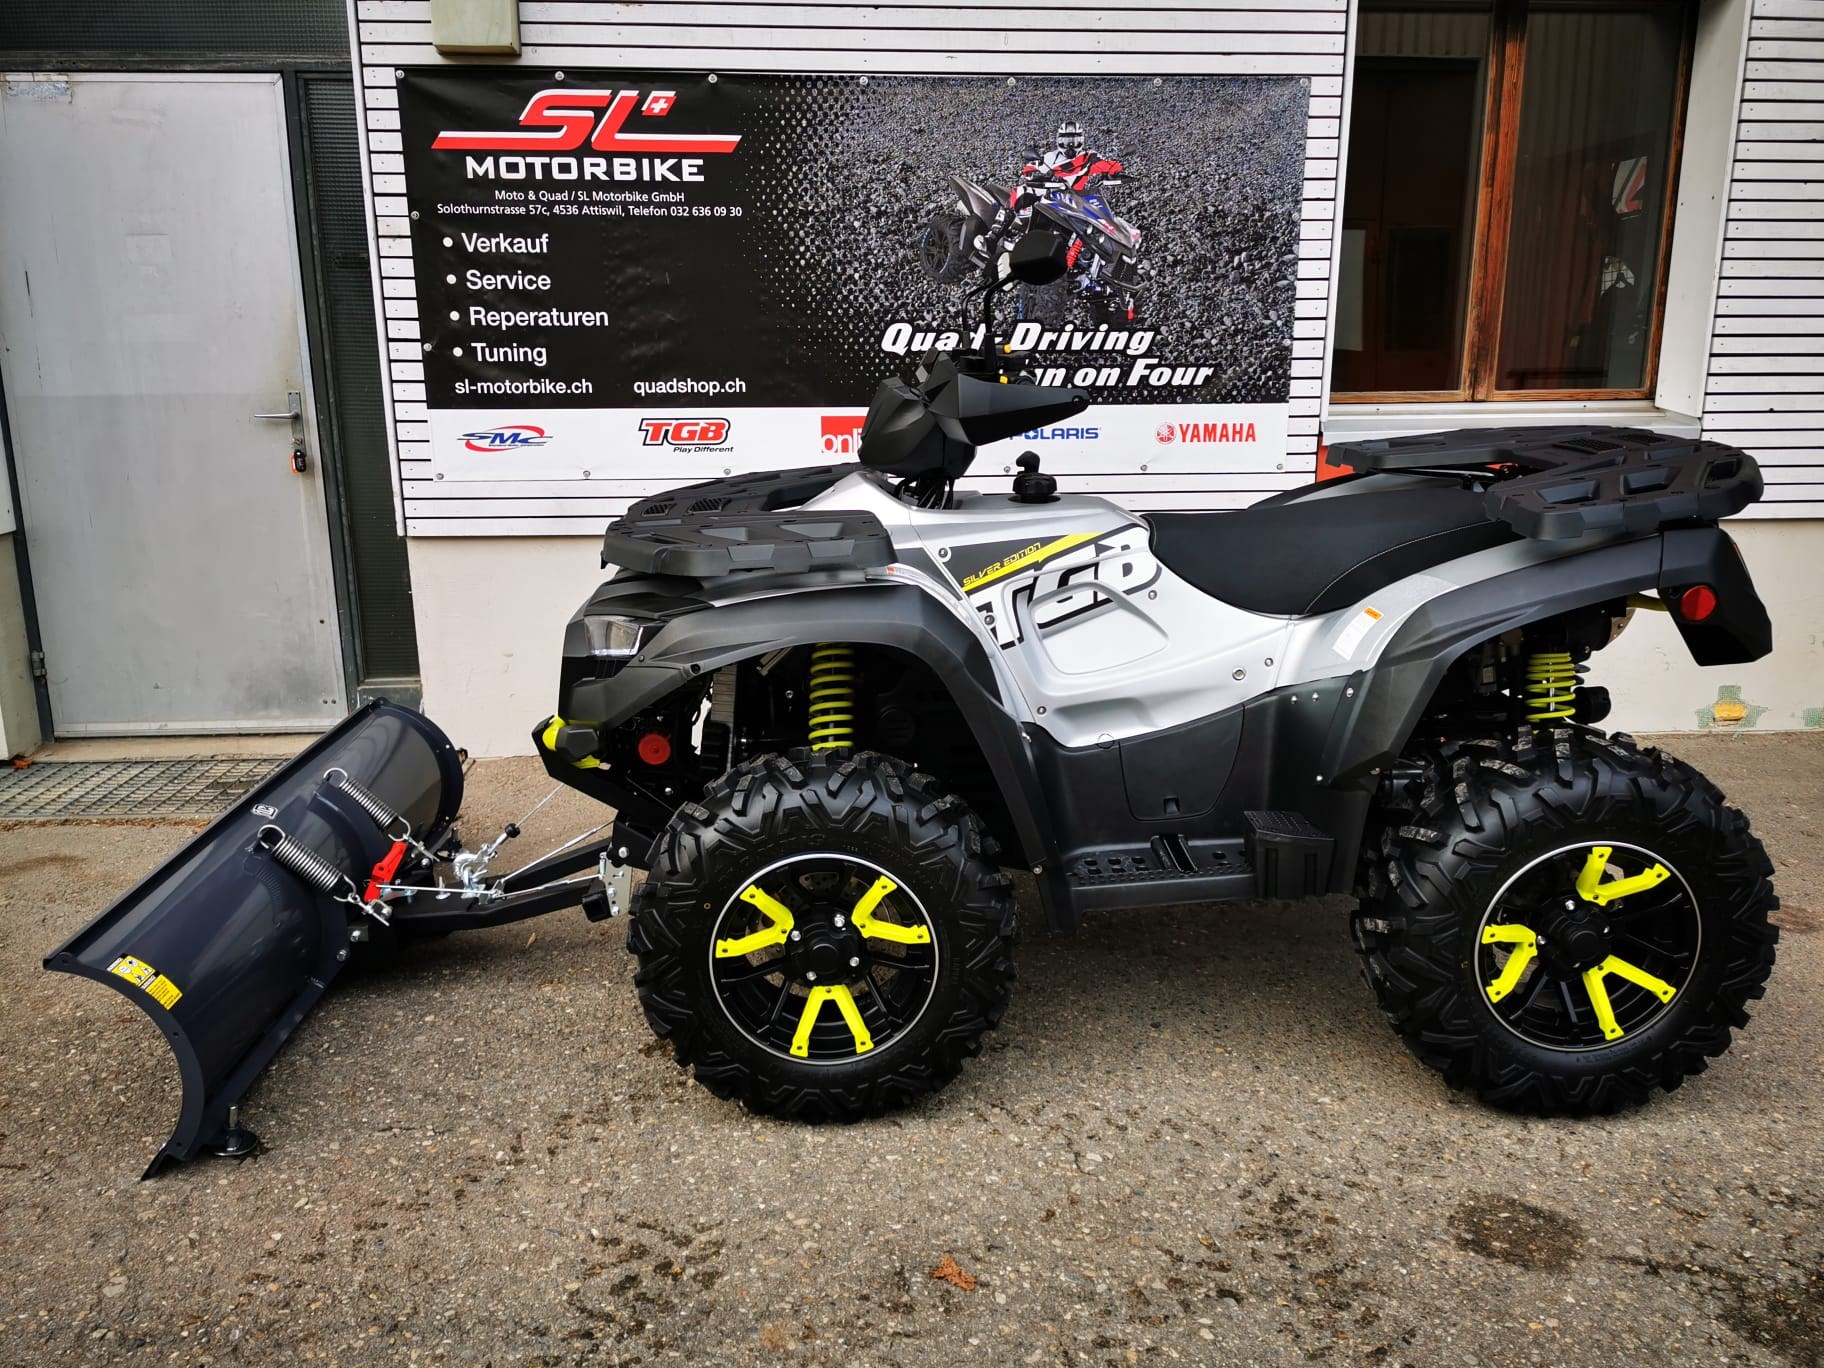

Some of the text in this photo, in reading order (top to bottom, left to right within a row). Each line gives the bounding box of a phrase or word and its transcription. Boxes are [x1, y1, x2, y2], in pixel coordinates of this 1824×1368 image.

[431, 89, 742, 153] SL
[465, 155, 705, 182] MOTORBIKE
[495, 190, 525, 200] Moto
[528, 190, 536, 200] &
[539, 190, 569, 201] Quad
[578, 190, 590, 201] SL
[592, 190, 649, 202] Motorbike
[651, 191, 685, 202] GmbH
[437, 203, 743, 217] Solothurnstrasse 57c, 4536 Attiswil, Telefon 032 636 09 30
[461, 233, 549, 253] Verkauf
[465, 270, 551, 290] Service
[469, 307, 609, 330] Reperaturen
[471, 343, 547, 366] Tuning
[1073, 366, 1121, 387] on
[1126, 358, 1214, 387] Four
[454, 378, 593, 395] sl-motorbike.ch
[633, 378, 746, 396] quadshop.ch
[641, 419, 729, 444] TGB
[1009, 428, 1098, 440] OLARIS
[1179, 423, 1257, 443] YAMAHA
[673, 446, 693, 454] Play
[963, 542, 1041, 586] SILVER EDITION
